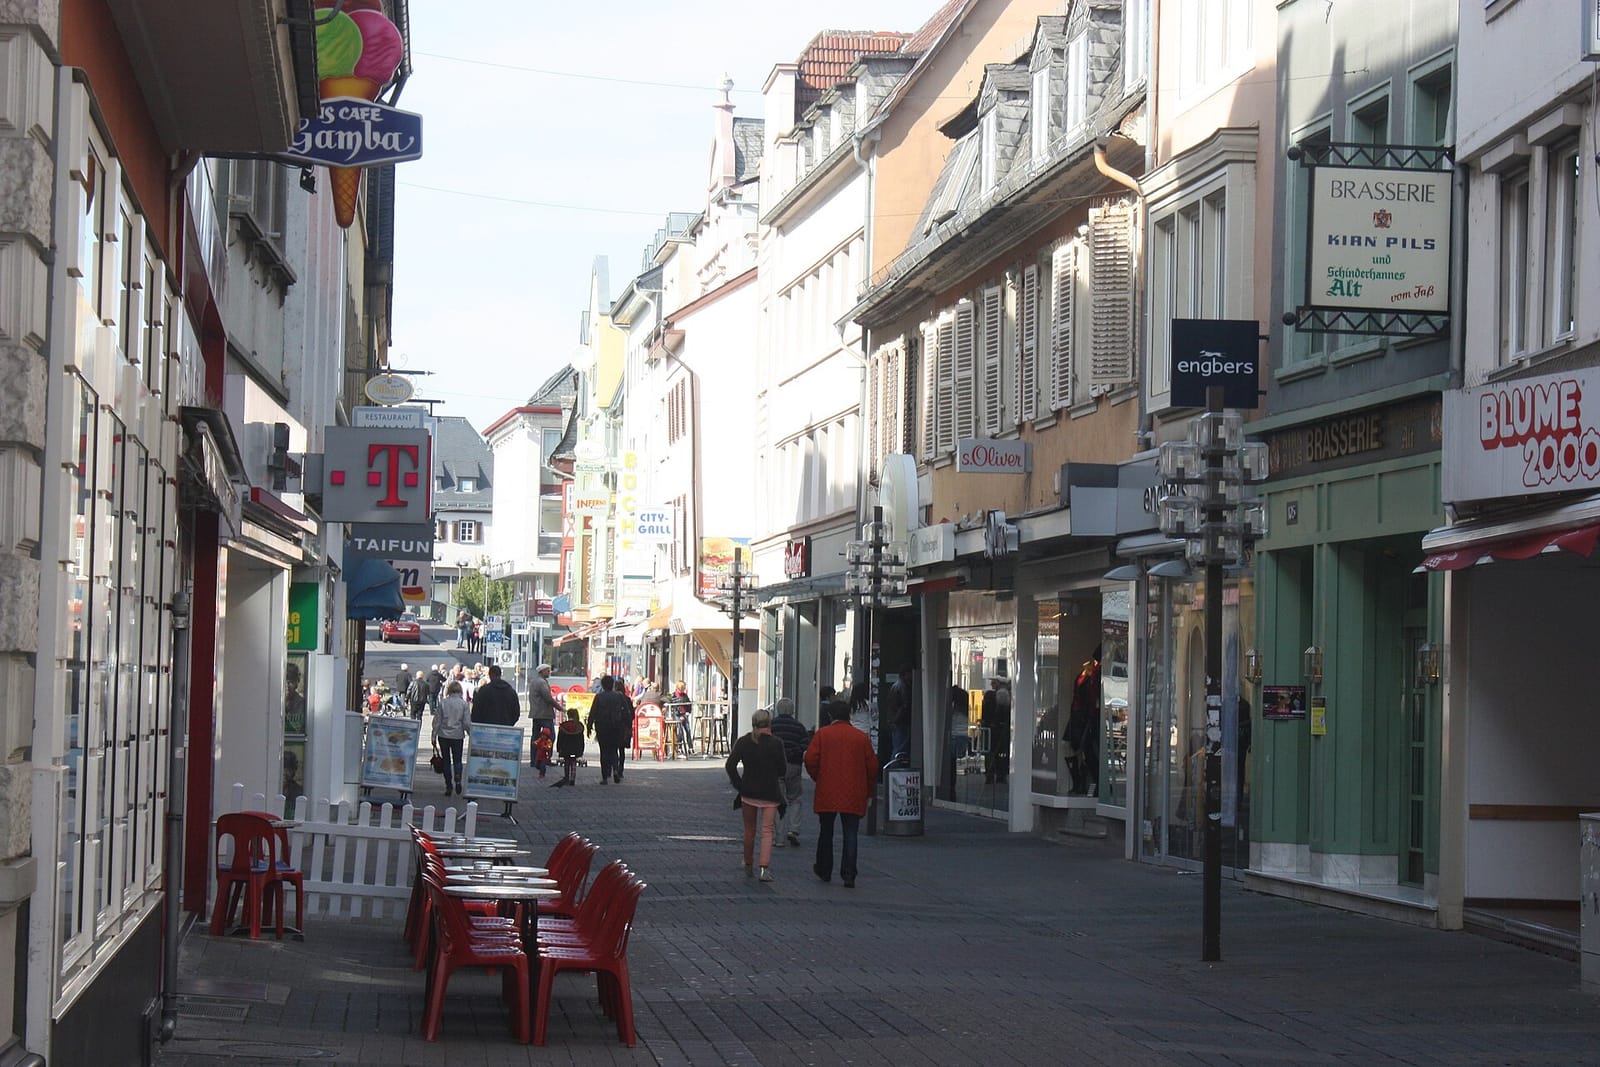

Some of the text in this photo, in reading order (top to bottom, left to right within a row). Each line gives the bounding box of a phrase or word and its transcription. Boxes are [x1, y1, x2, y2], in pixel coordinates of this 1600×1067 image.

[319, 106, 383, 124] IS CAFE
[287, 117, 414, 161] Gamba
[1331, 180, 1436, 203] BRASSERIE
[1328, 234, 1435, 250] KIRN PILS
[1372, 254, 1391, 265] und
[1327, 266, 1406, 280] Schinderhannes
[1326, 278, 1362, 297] Alt
[1390, 292, 1411, 303] vom
[1177, 356, 1254, 378] engbers
[364, 412, 413, 422] RESTAURANT
[1480, 379, 1582, 451] BLUME
[1306, 415, 1380, 462] BRASSERIE
[962, 444, 1023, 468] s.Oliver
[1523, 426, 1600, 488] 2000
[368, 443, 419, 507] T
[640, 513, 669, 522] CITY-
[638, 525, 671, 534] GRILL
[354, 537, 430, 554] TAIFUN
[388, 560, 419, 586] m
[906, 775, 920, 785] NIT
[906, 798, 919, 807] DIE
